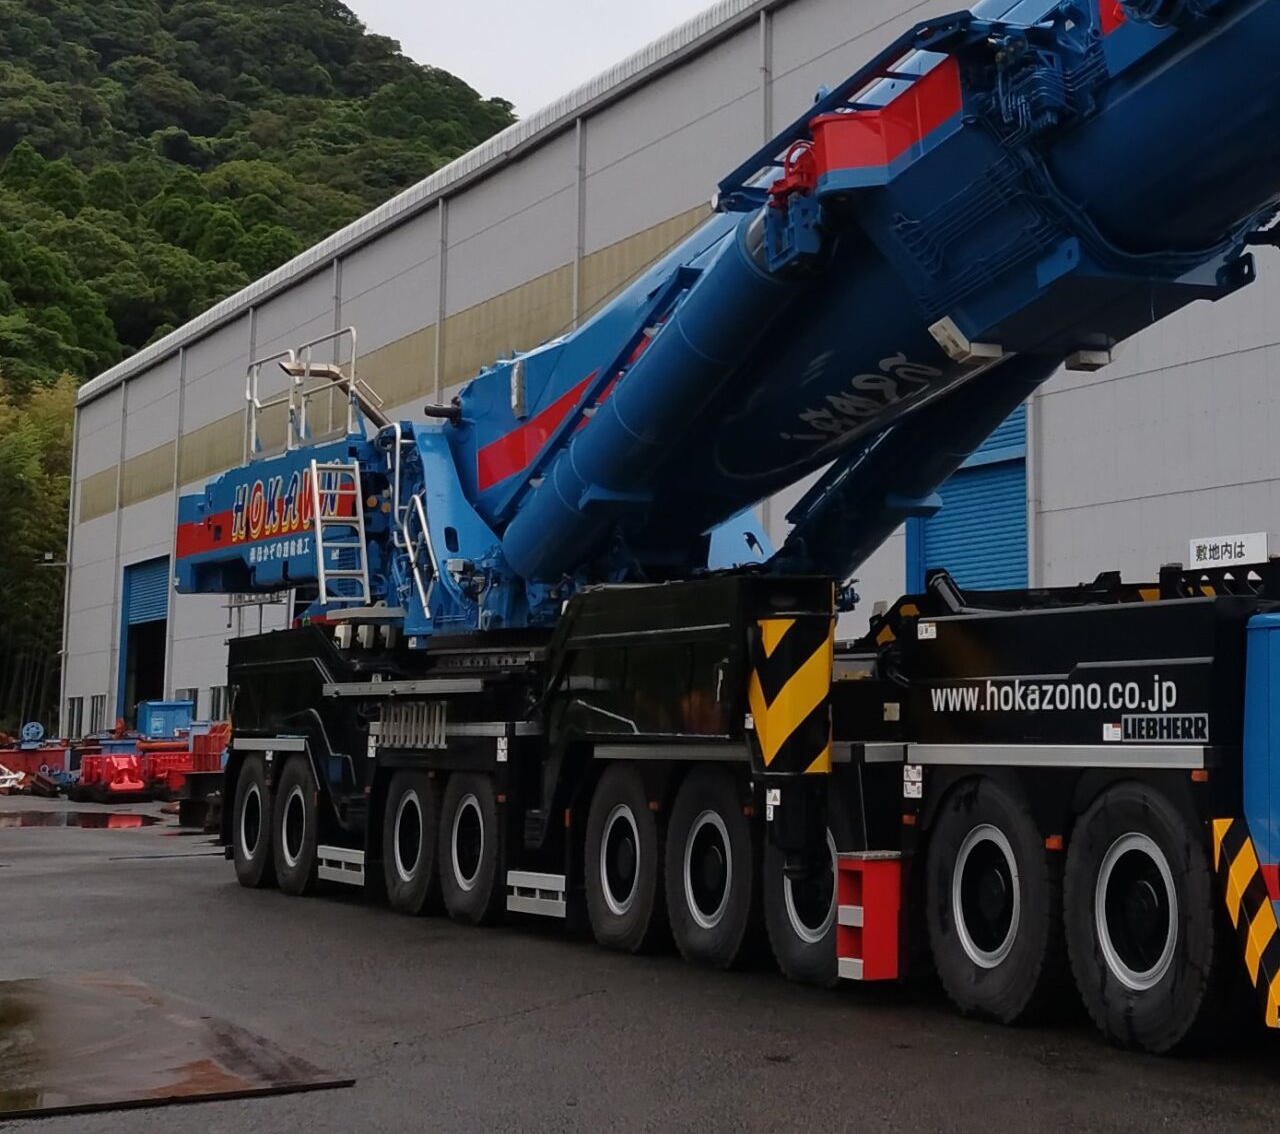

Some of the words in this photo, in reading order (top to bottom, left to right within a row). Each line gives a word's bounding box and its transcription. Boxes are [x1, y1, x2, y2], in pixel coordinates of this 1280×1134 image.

[1195, 541, 1246, 562] 敷地内は
[931, 674, 1177, 712] www.hokazono.co.jp
[1122, 715, 1209, 741] LIEBHERR
